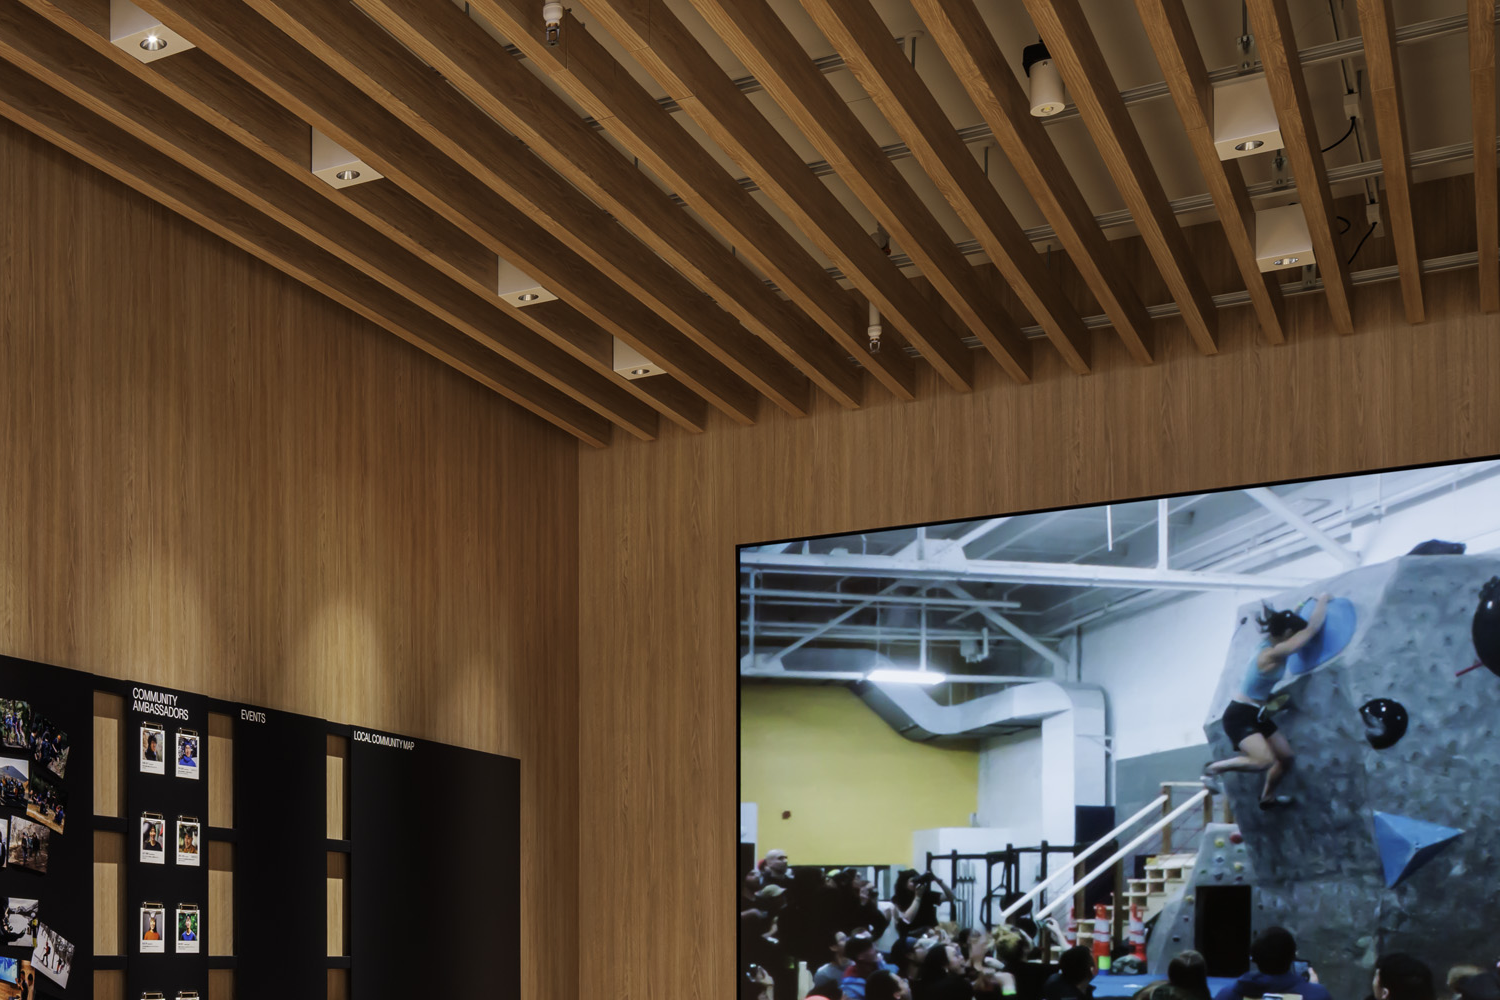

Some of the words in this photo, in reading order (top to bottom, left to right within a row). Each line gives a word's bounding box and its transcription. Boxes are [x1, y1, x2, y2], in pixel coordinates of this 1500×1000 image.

[132, 687, 179, 706] COMMUNITY
[132, 700, 189, 721] AMBASSADORS
[240, 709, 267, 724] EVENTS
[353, 730, 371, 743] LOCAL
[371, 734, 402, 748] COMMUNITY
[403, 740, 415, 750] MAP
